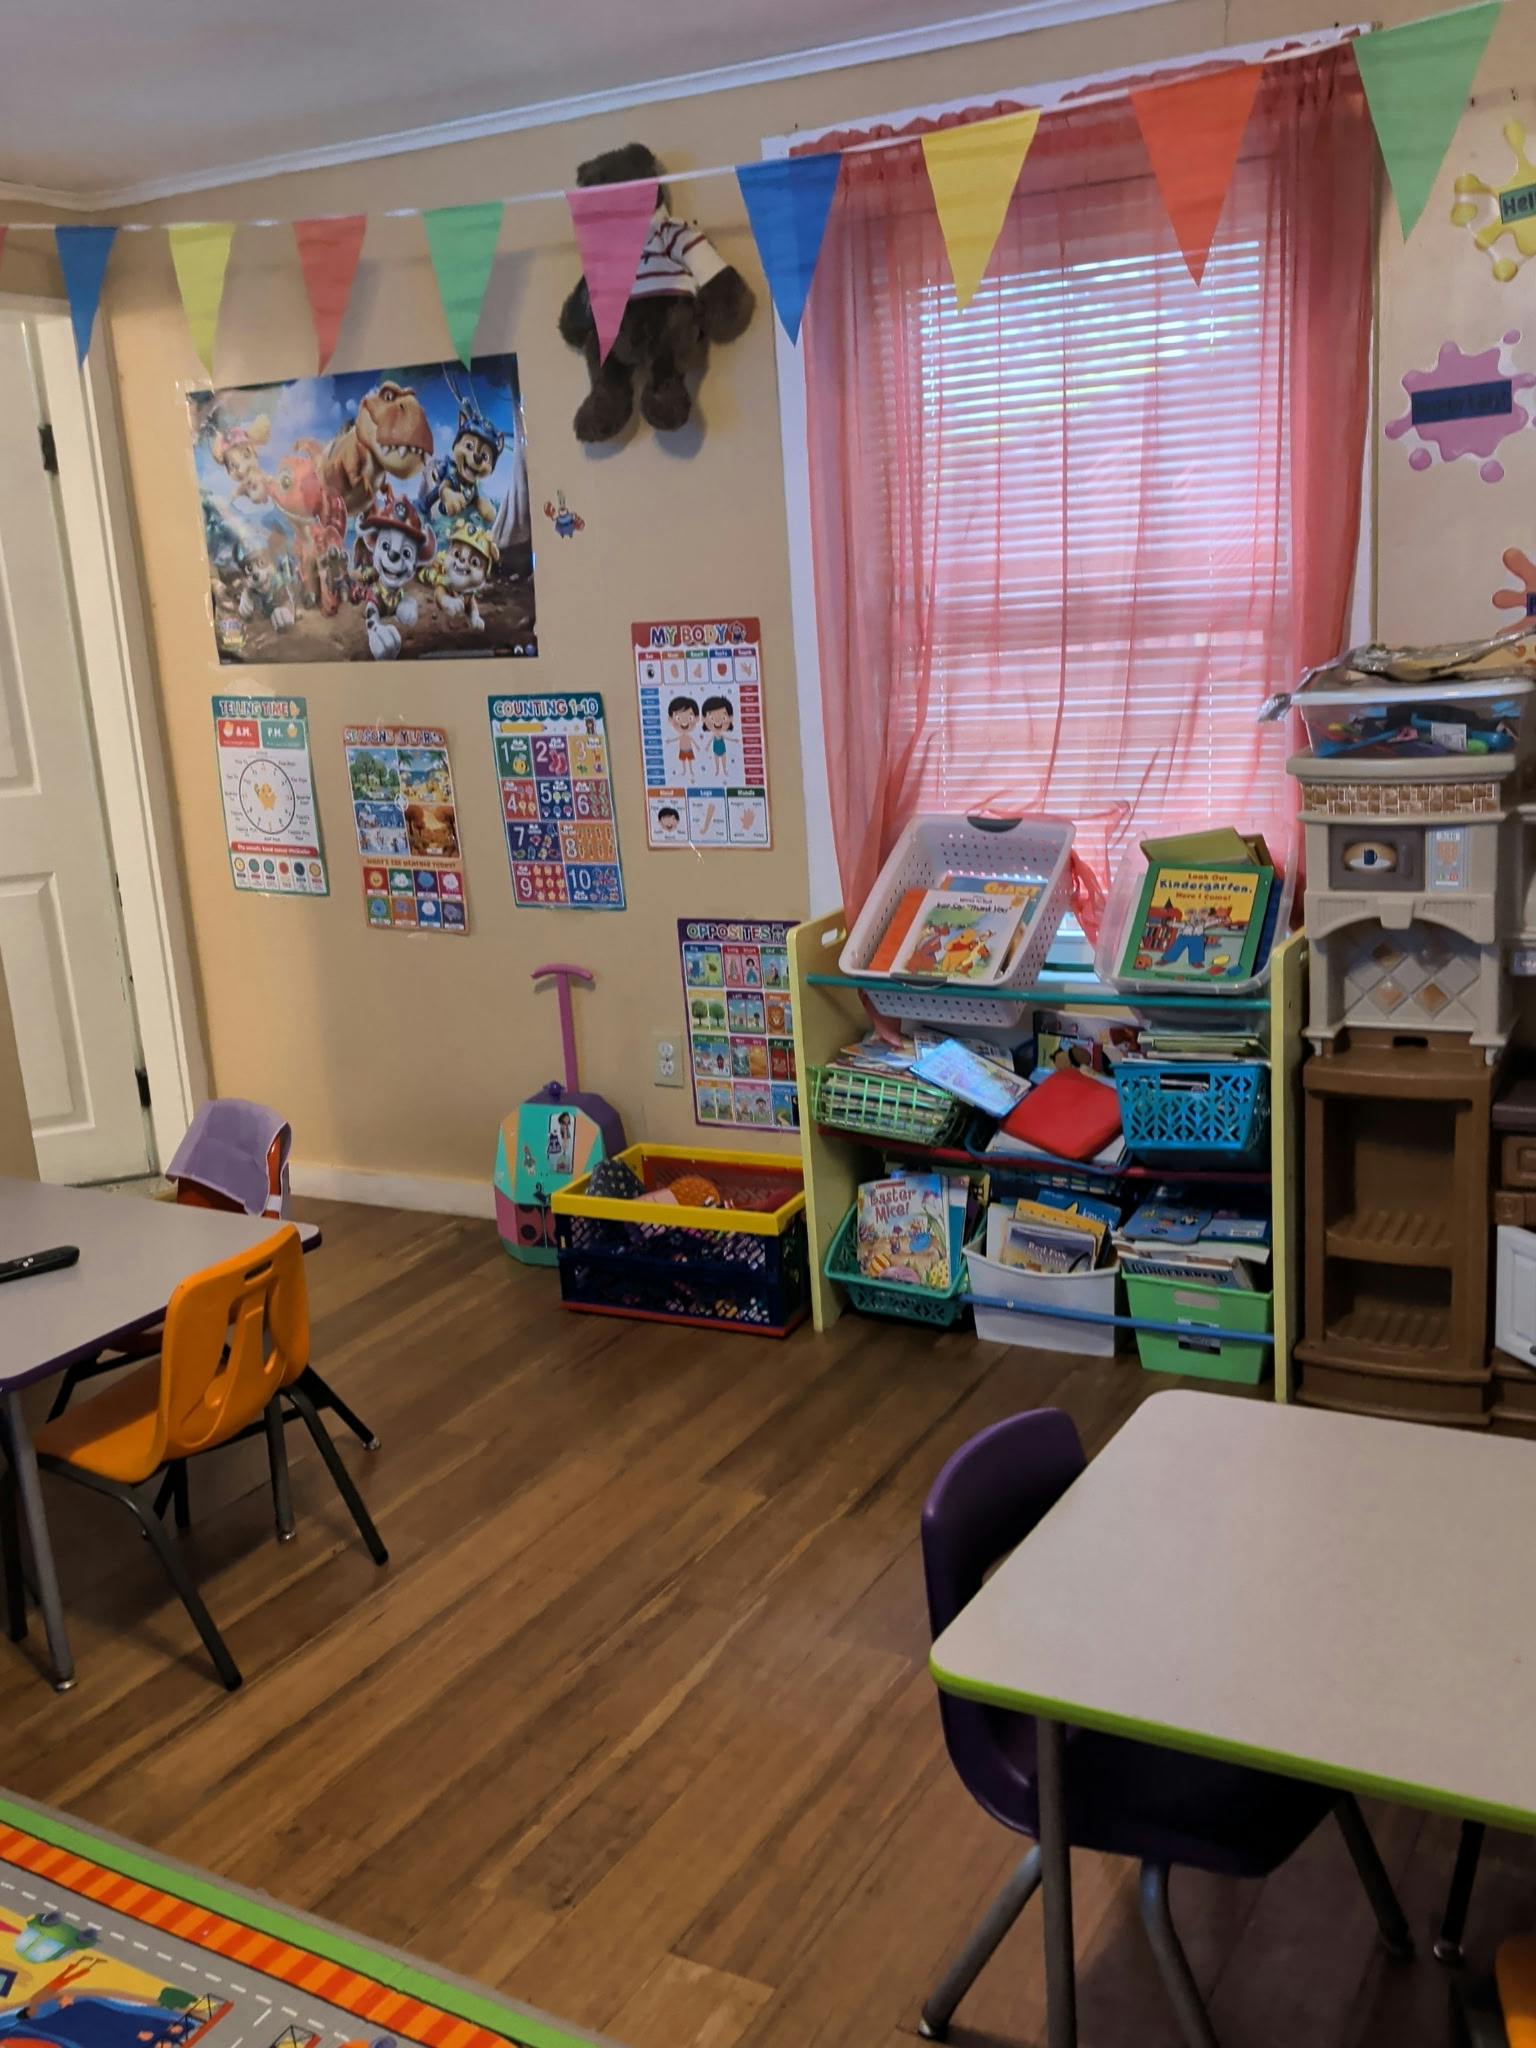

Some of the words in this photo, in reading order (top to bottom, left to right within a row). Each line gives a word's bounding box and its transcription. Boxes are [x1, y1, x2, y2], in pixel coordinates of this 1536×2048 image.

[650, 625, 677, 647] MY
[680, 623, 728, 646] BODY
[262, 701, 288, 716] TIME
[493, 698, 568, 718] COUNTING
[568, 697, 599, 716] 1-10
[501, 741, 510, 764] 1
[535, 741, 549, 763] 2
[575, 741, 587, 762] 3
[507, 792, 518, 815] 4
[540, 782, 553, 804] 5
[577, 793, 590, 816] 6
[513, 826, 525, 848] 7
[566, 838, 578, 858] 8
[520, 877, 533, 899] 9
[568, 867, 592, 891] 10
[1159, 879, 1253, 894] Kindergarten,
[687, 922, 771, 940] OPPOSITES
[870, 1187, 917, 1206] Easter
[875, 1201, 910, 1224] Mice!
